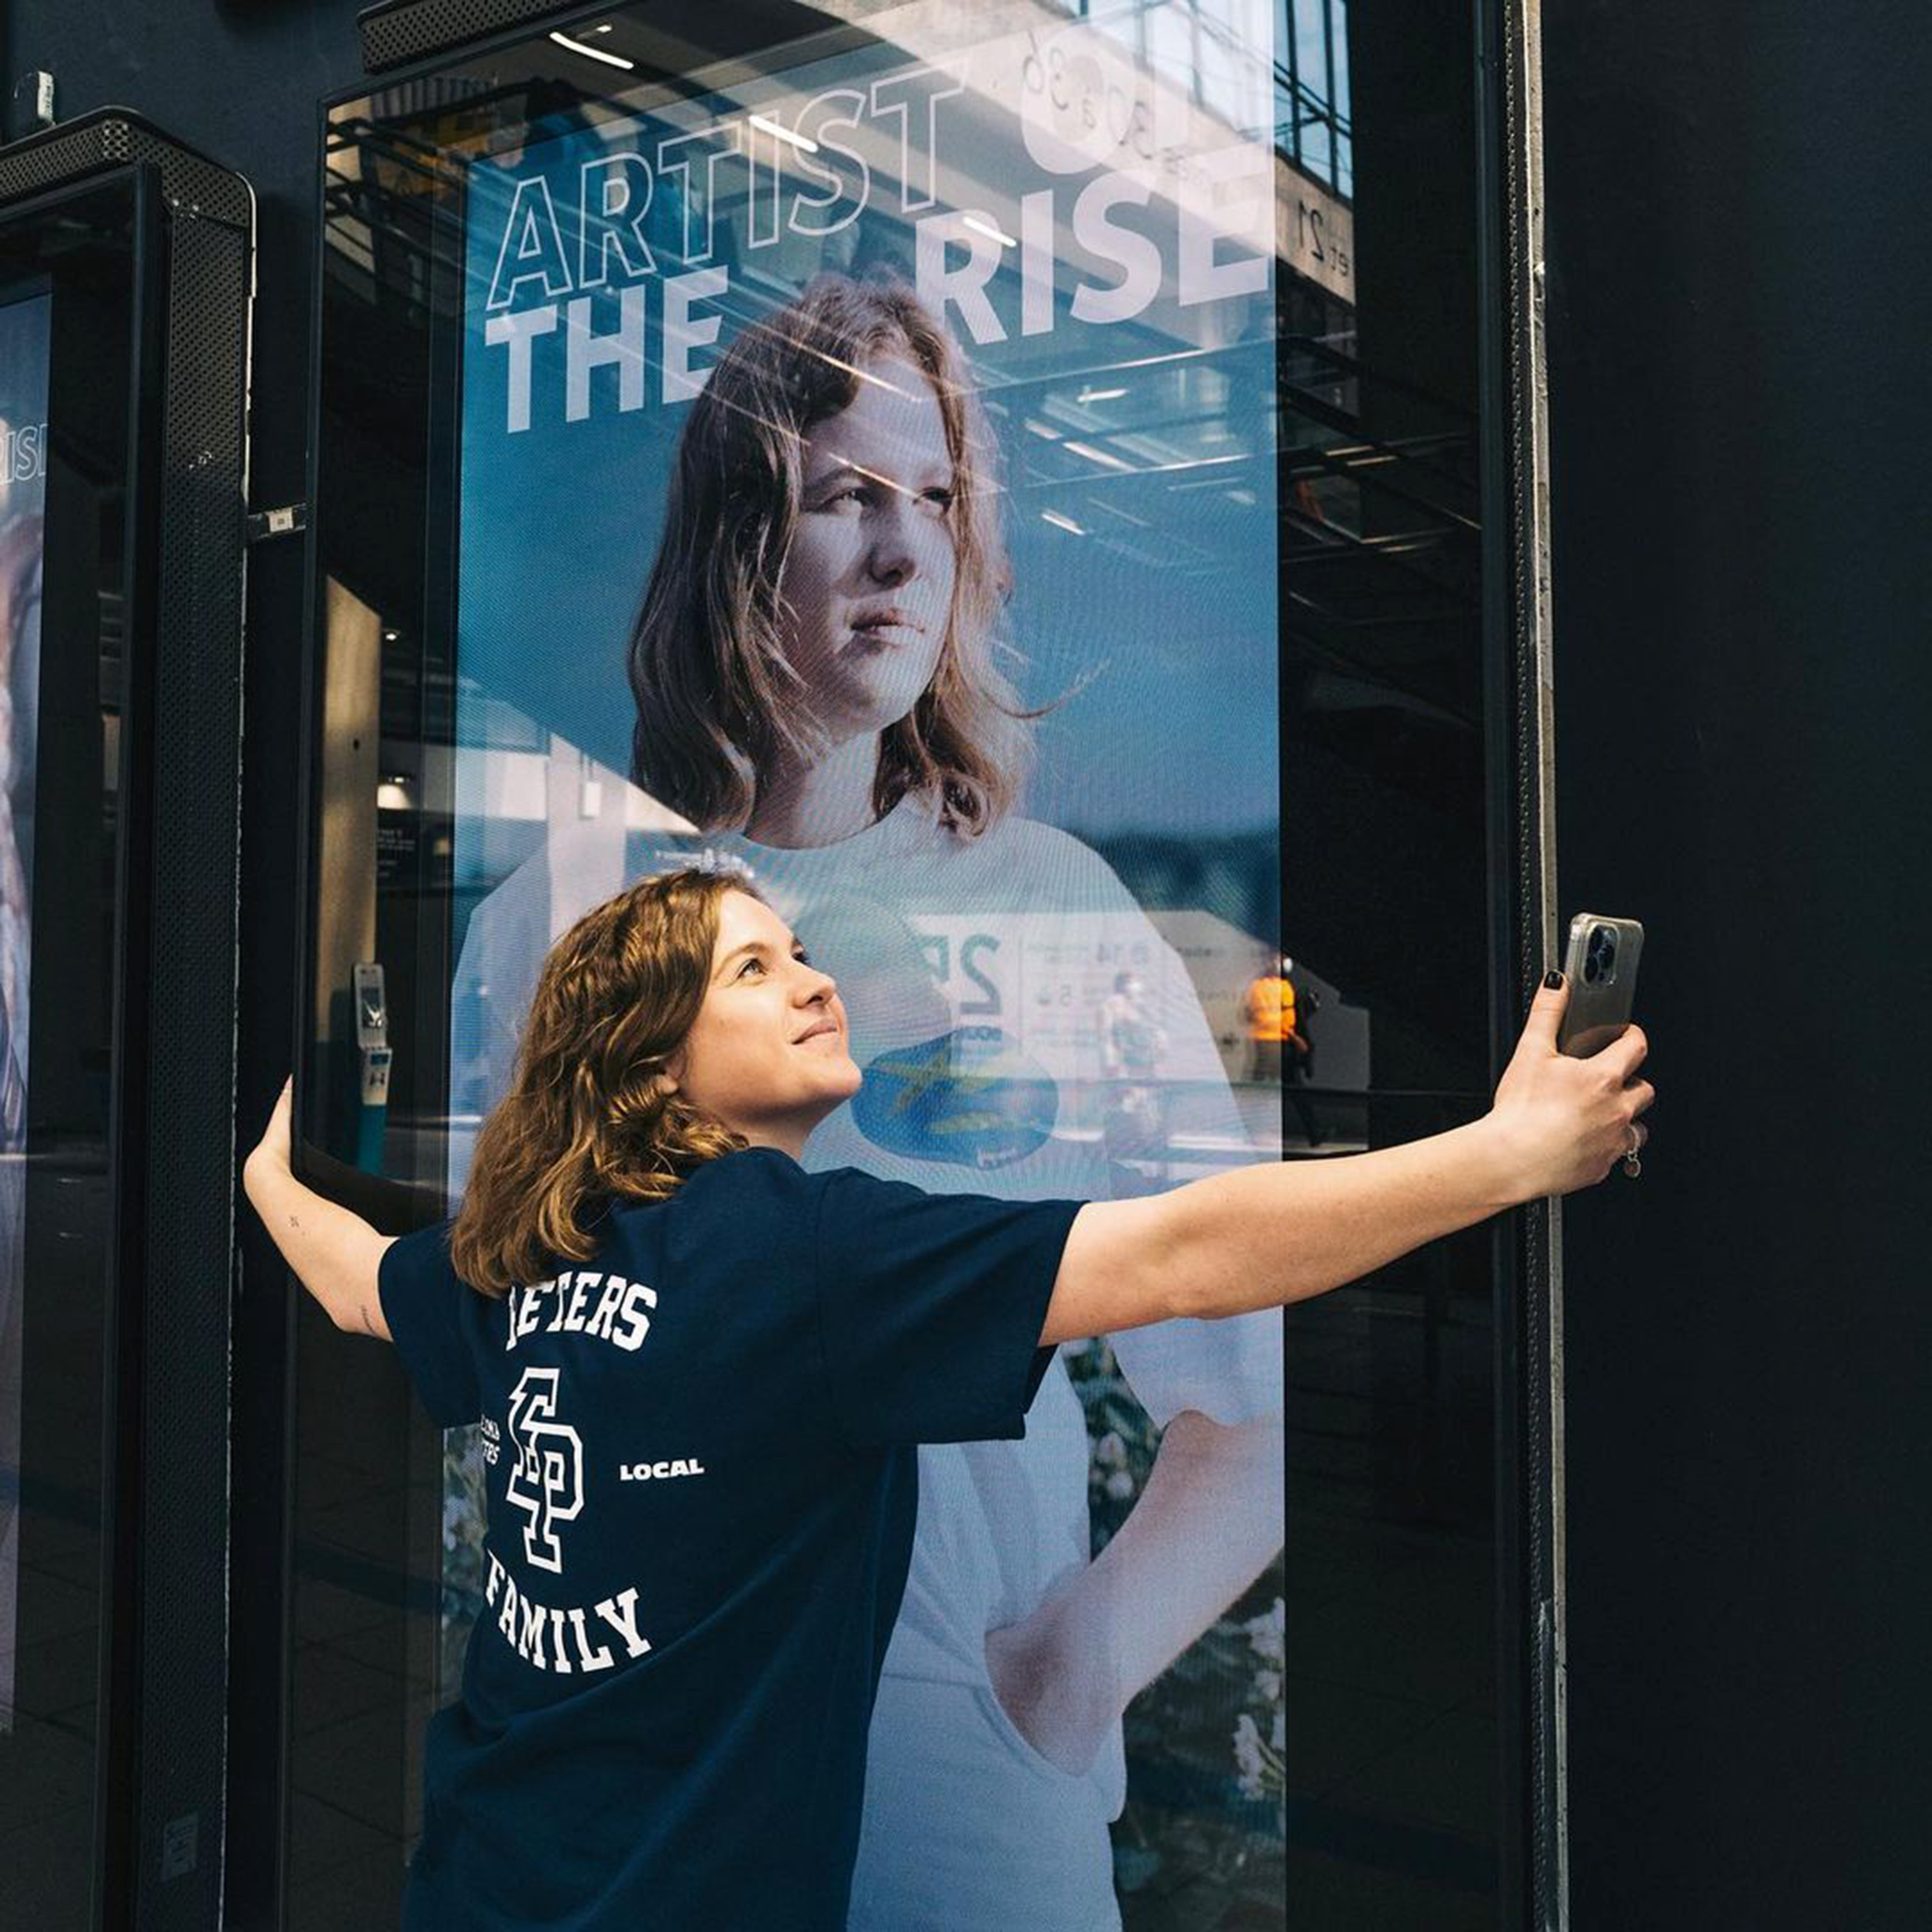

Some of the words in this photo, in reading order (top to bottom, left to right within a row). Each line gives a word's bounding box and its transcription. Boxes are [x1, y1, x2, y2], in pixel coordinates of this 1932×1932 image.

[486, 61, 967, 311] ARTIST
[486, 266, 729, 434] THE
[916, 141, 1271, 346] RISE
[619, 1459, 705, 1482] LOCAL
[485, 1548, 652, 1674] FAMILY
